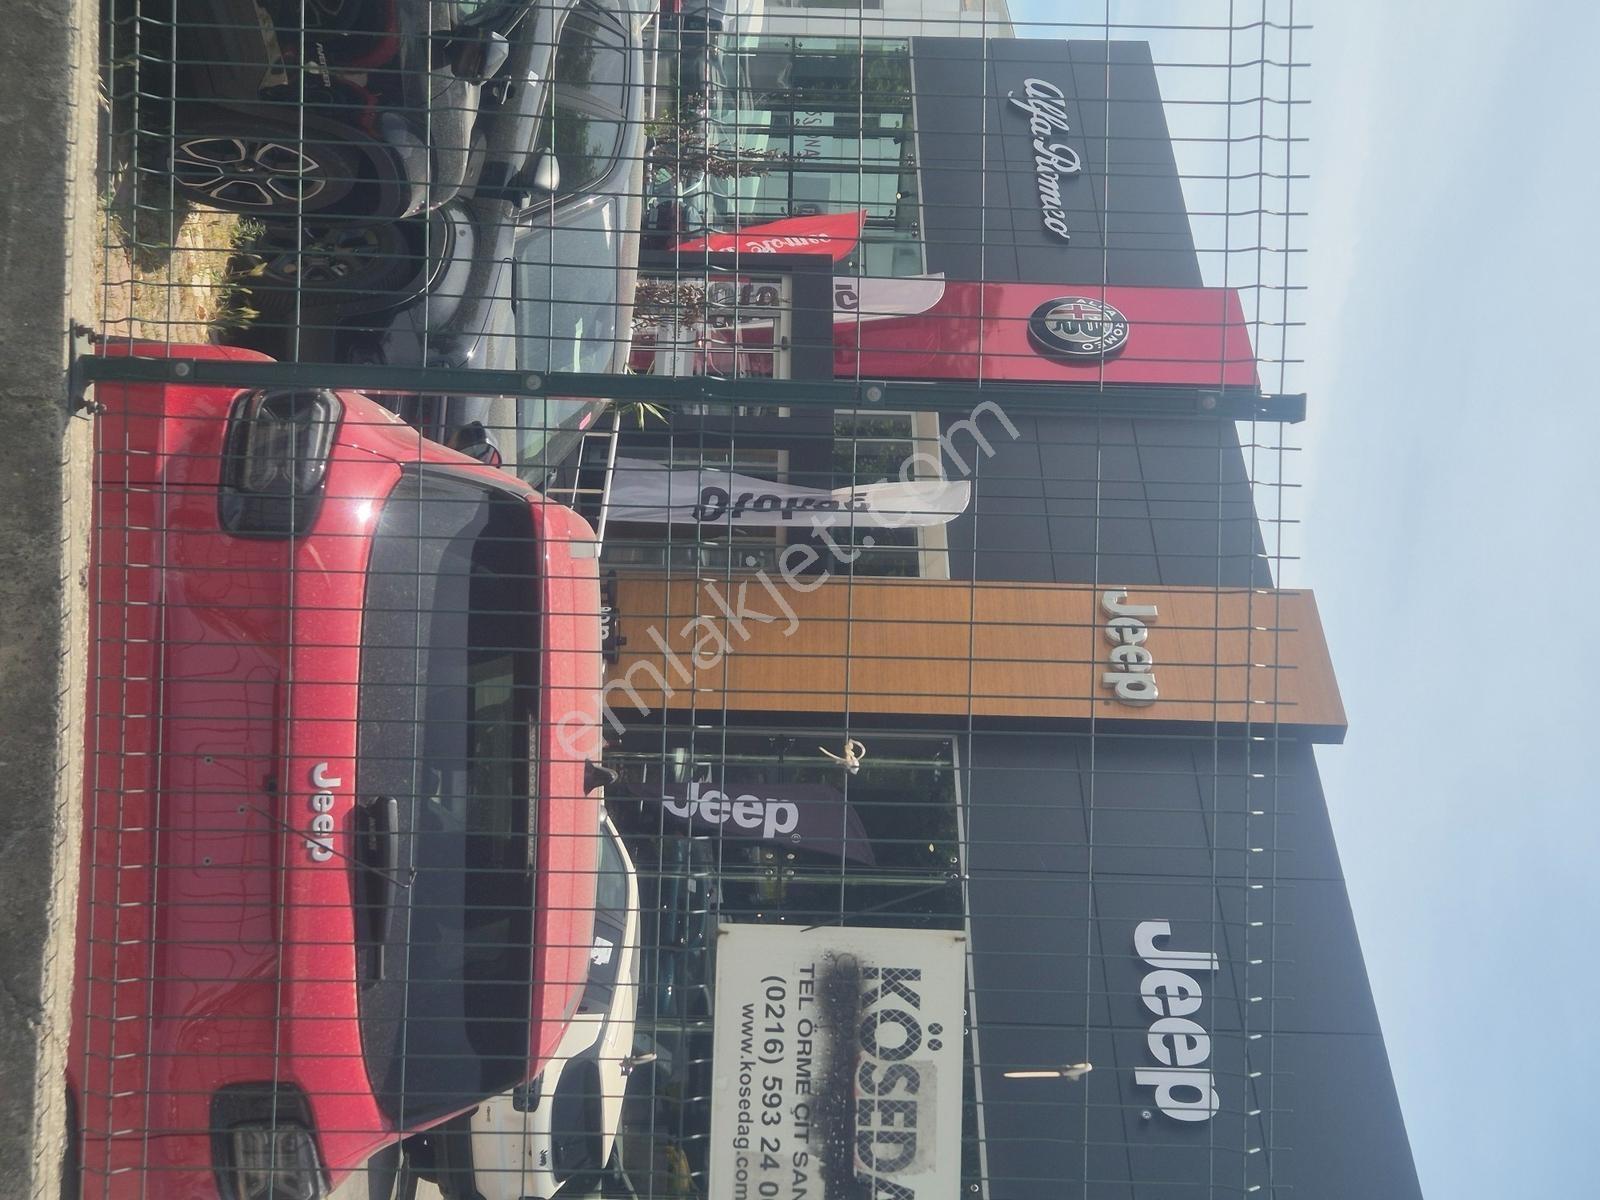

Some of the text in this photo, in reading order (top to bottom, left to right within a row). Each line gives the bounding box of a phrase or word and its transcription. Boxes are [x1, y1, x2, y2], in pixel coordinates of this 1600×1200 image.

[316, 42, 331, 87] AVEGER
[1008, 78, 1082, 240] Alfa Romeo
[1102, 586, 1159, 705] Jeep
[306, 762, 341, 862] Jeep
[662, 782, 799, 838] Jeep
[798, 963, 816, 1011] TEL
[1134, 919, 1220, 1122] Jeep
[758, 976, 787, 1200] (0216) 593 24 0
[795, 1018, 817, 1095] ÖRME
